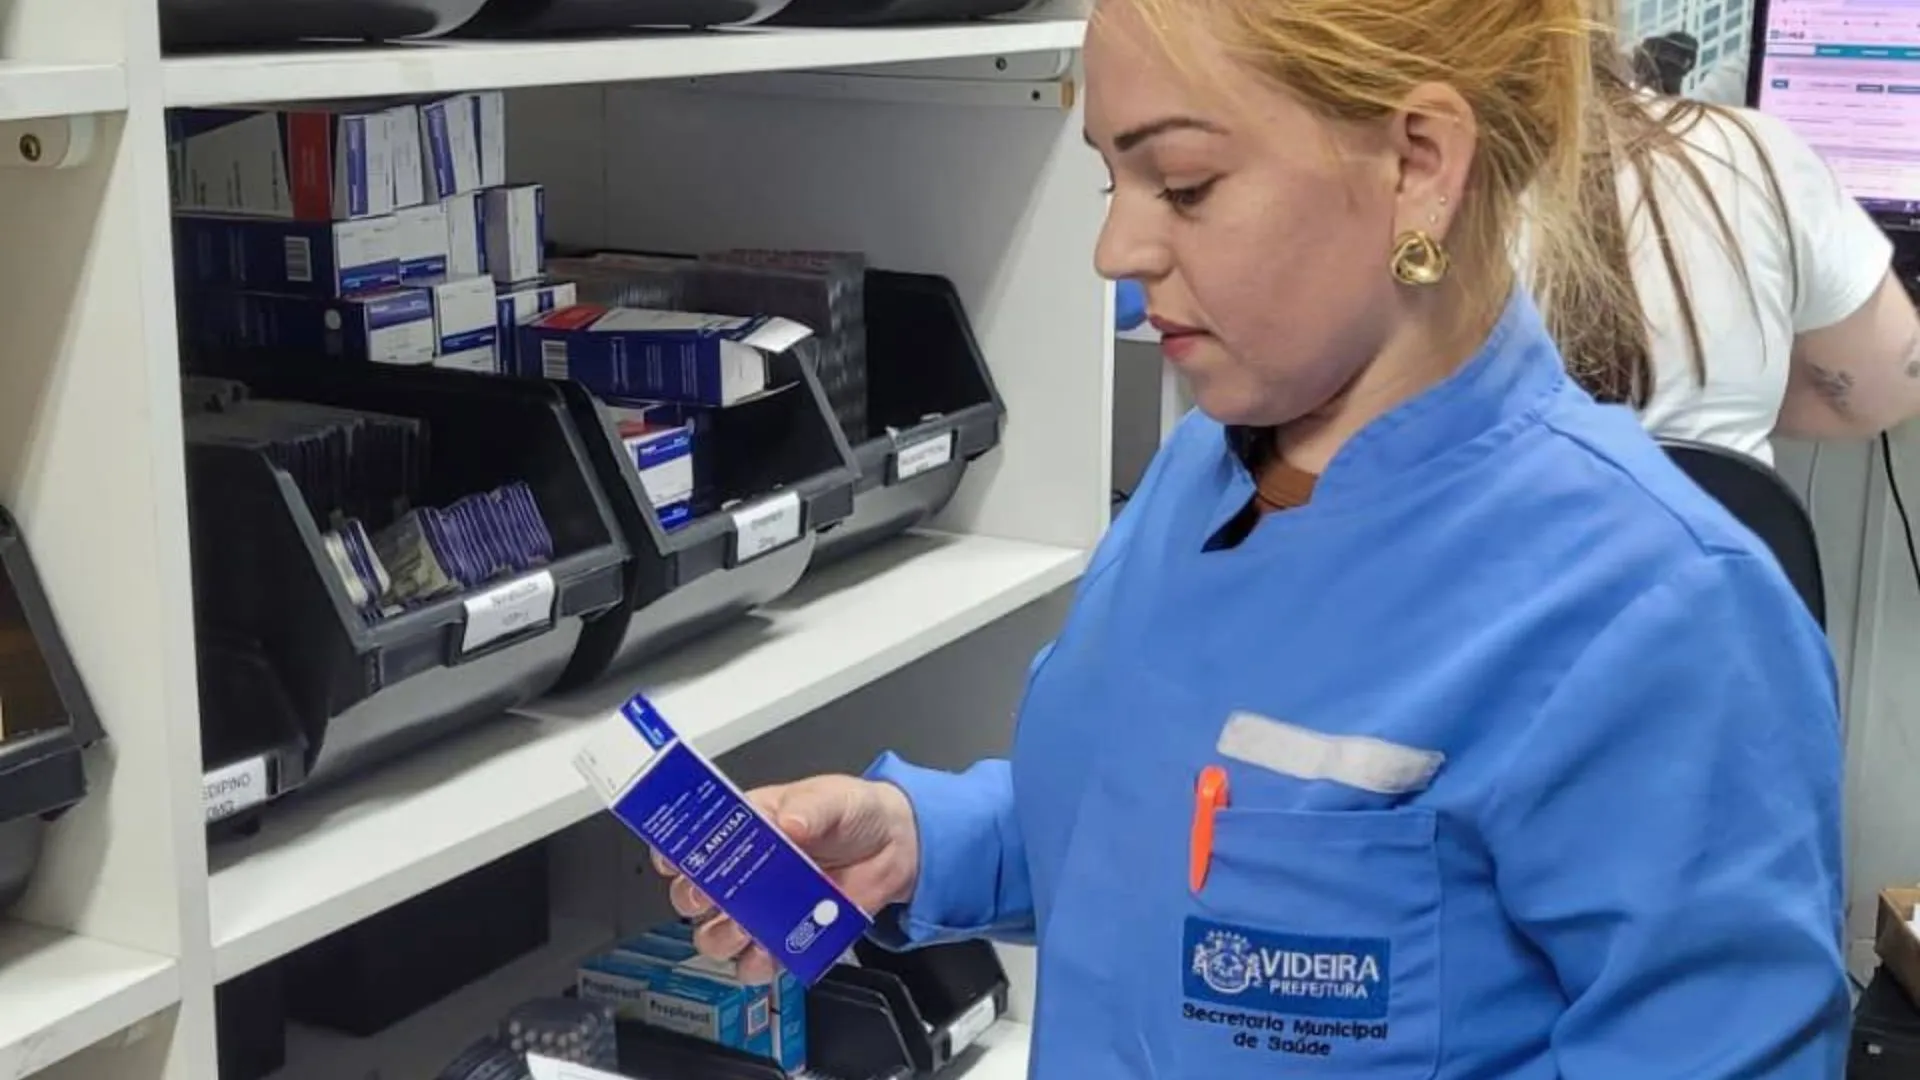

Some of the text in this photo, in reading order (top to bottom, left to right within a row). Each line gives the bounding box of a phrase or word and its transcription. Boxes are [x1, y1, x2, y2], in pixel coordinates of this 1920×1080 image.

[704, 810, 748, 855] ANVISA
[1259, 947, 1380, 982] VIDEIRA
[1269, 979, 1369, 1000] PREFEITURA
[1182, 1002, 1388, 1041] Secretaria Municipal
[1233, 1031, 1331, 1056] de Saúde
